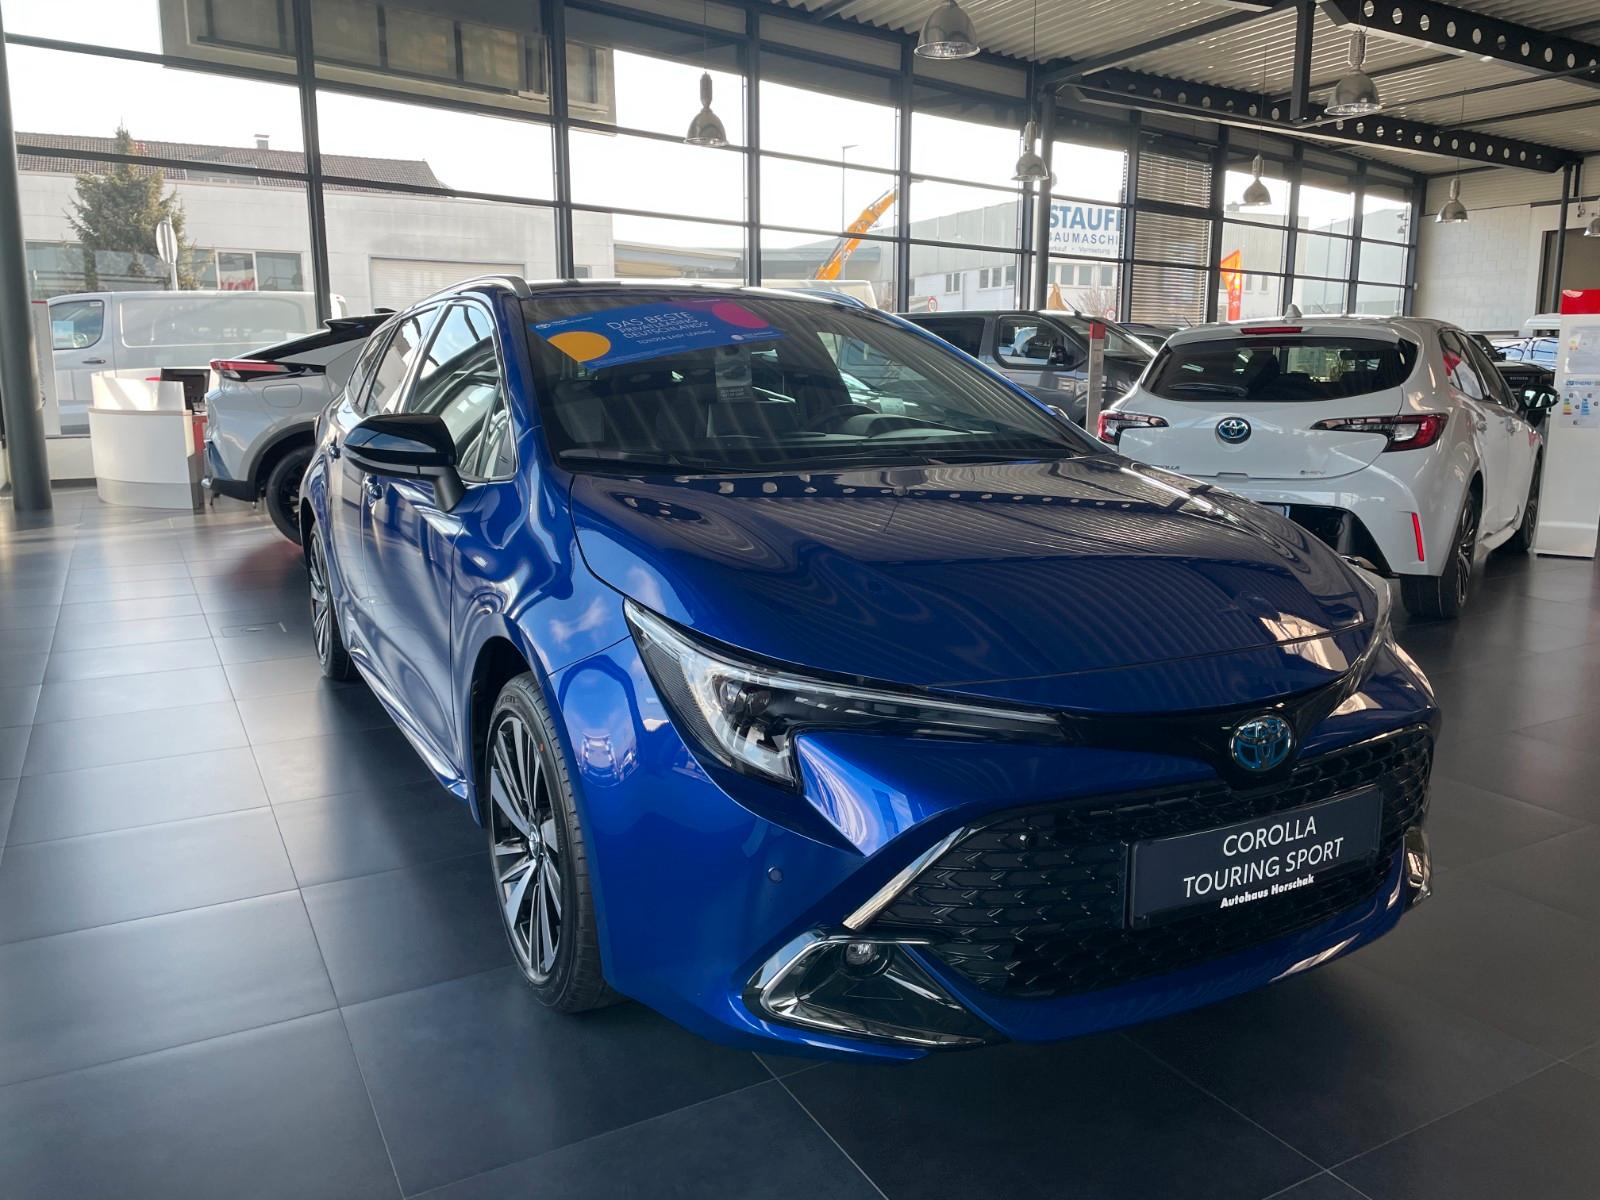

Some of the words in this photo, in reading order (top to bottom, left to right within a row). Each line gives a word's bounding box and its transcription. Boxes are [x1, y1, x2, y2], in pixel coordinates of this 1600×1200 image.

[606, 318, 643, 329] DAS
[643, 311, 694, 323] BESTE
[1223, 815, 1316, 857] COROLLA
[1183, 856, 1280, 898] TOURING
[1285, 837, 1344, 873] SPORT
[1220, 889, 1269, 909] Autohaus
[1271, 874, 1315, 895] Horschak
